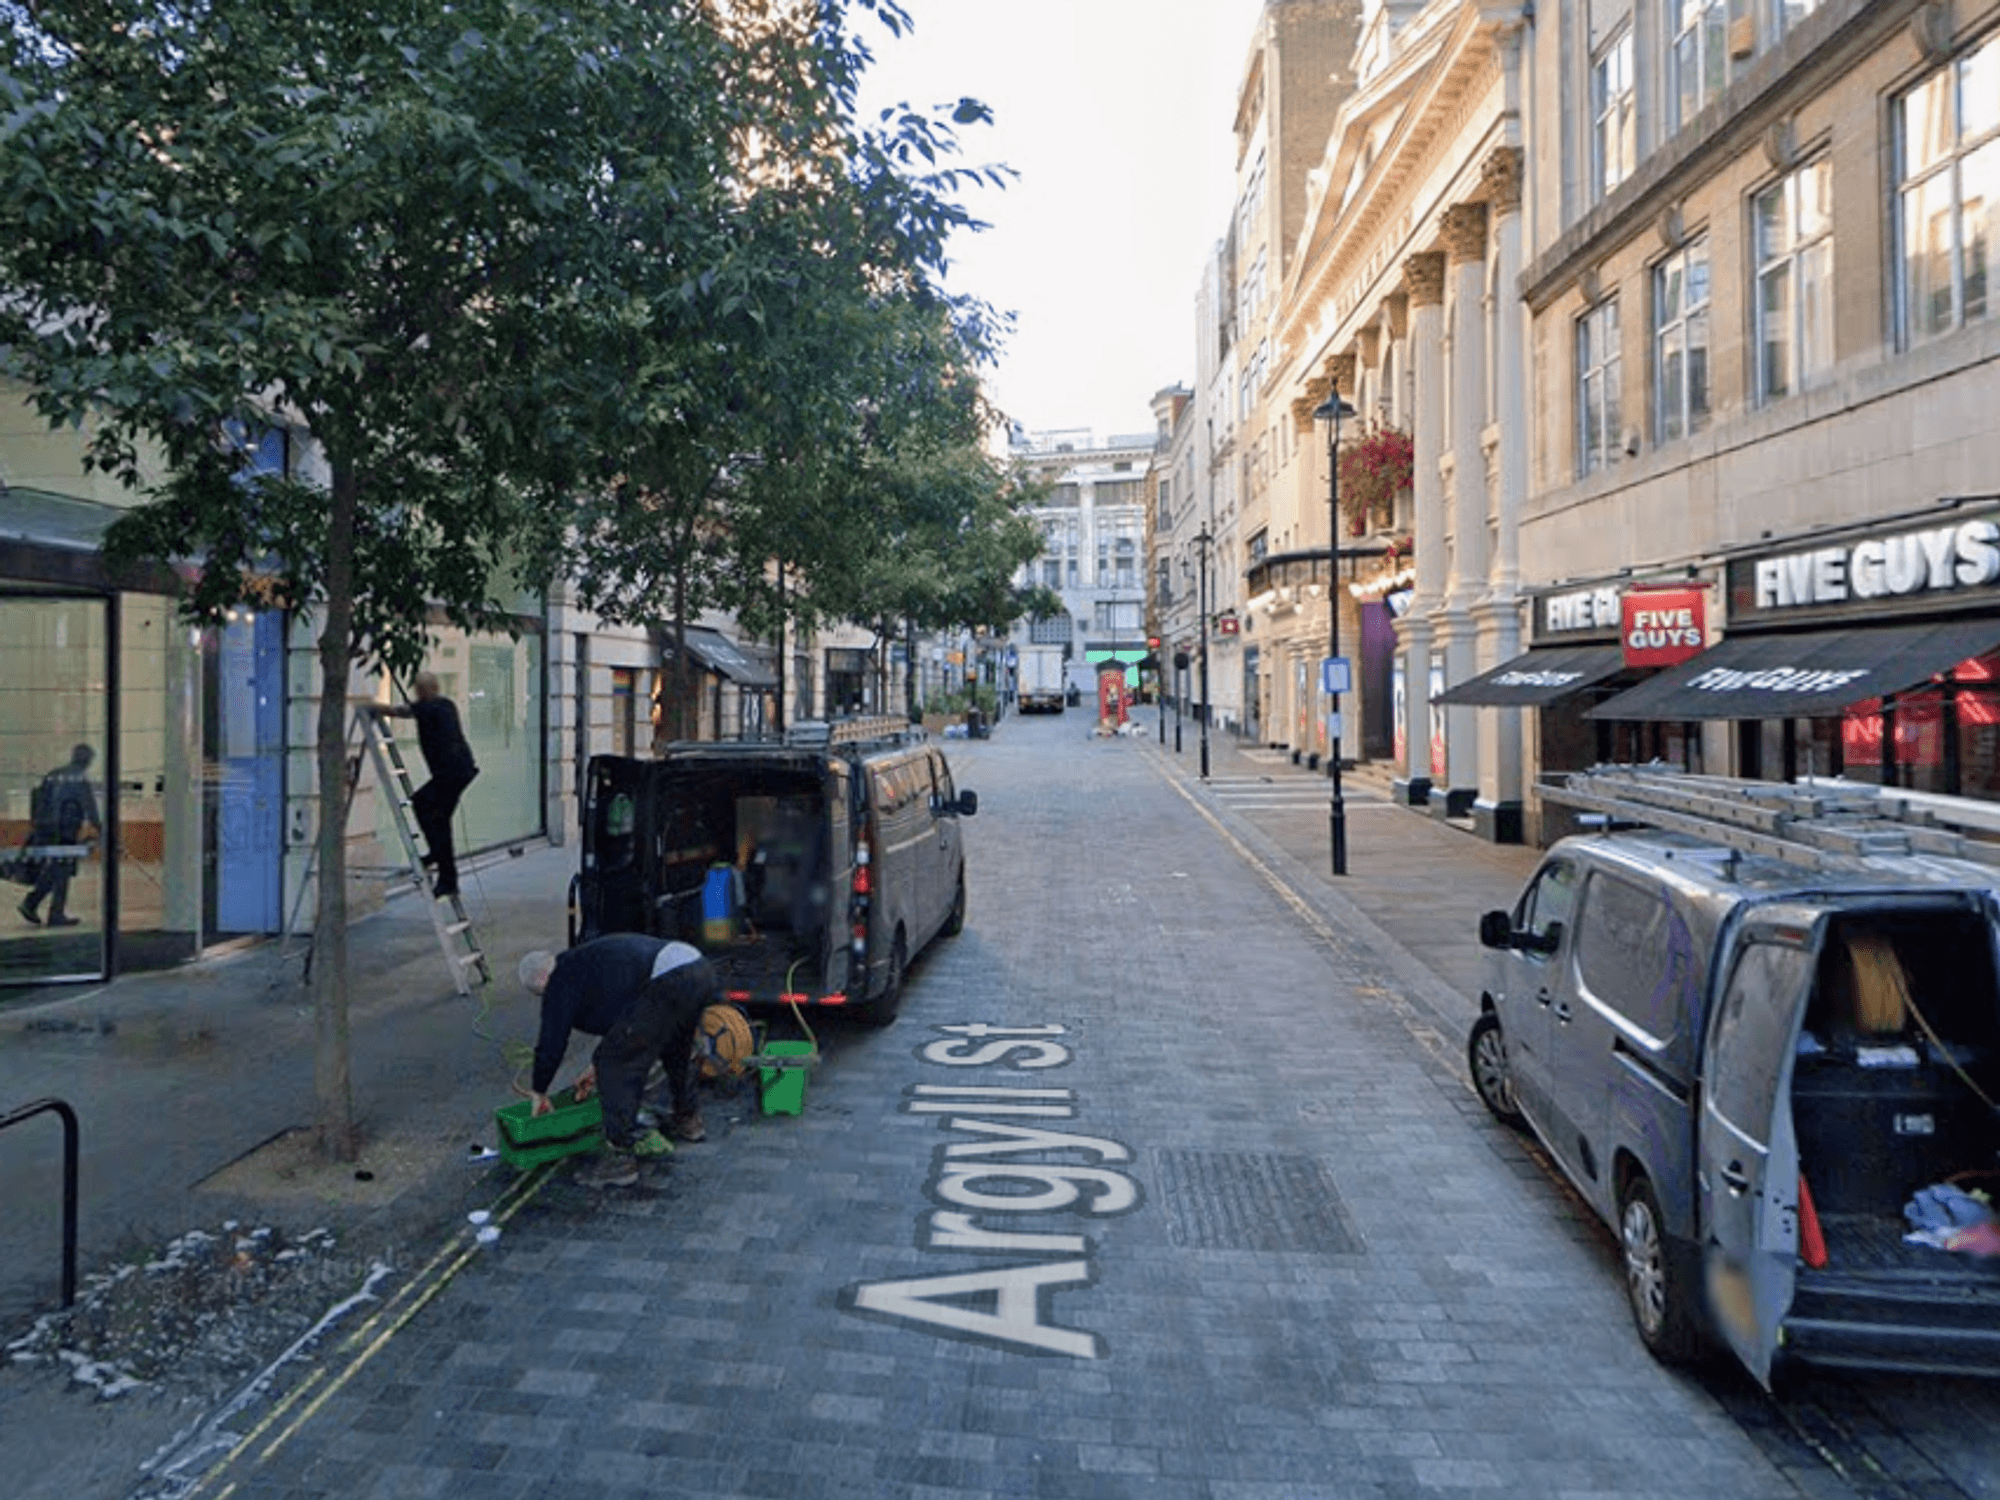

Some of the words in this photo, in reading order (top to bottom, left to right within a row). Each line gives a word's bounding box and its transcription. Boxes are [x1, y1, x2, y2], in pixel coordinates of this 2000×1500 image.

[1755, 548, 1848, 607] FIVE
[1851, 520, 1999, 598] GUYS
[1547, 592, 1593, 631] FIVE
[1593, 585, 1621, 627] GU
[1633, 608, 1693, 628] FIVE
[1628, 627, 1702, 649] GUYS
[922, 1023, 1070, 1069] St
[855, 1084, 1139, 1359] Argyll
